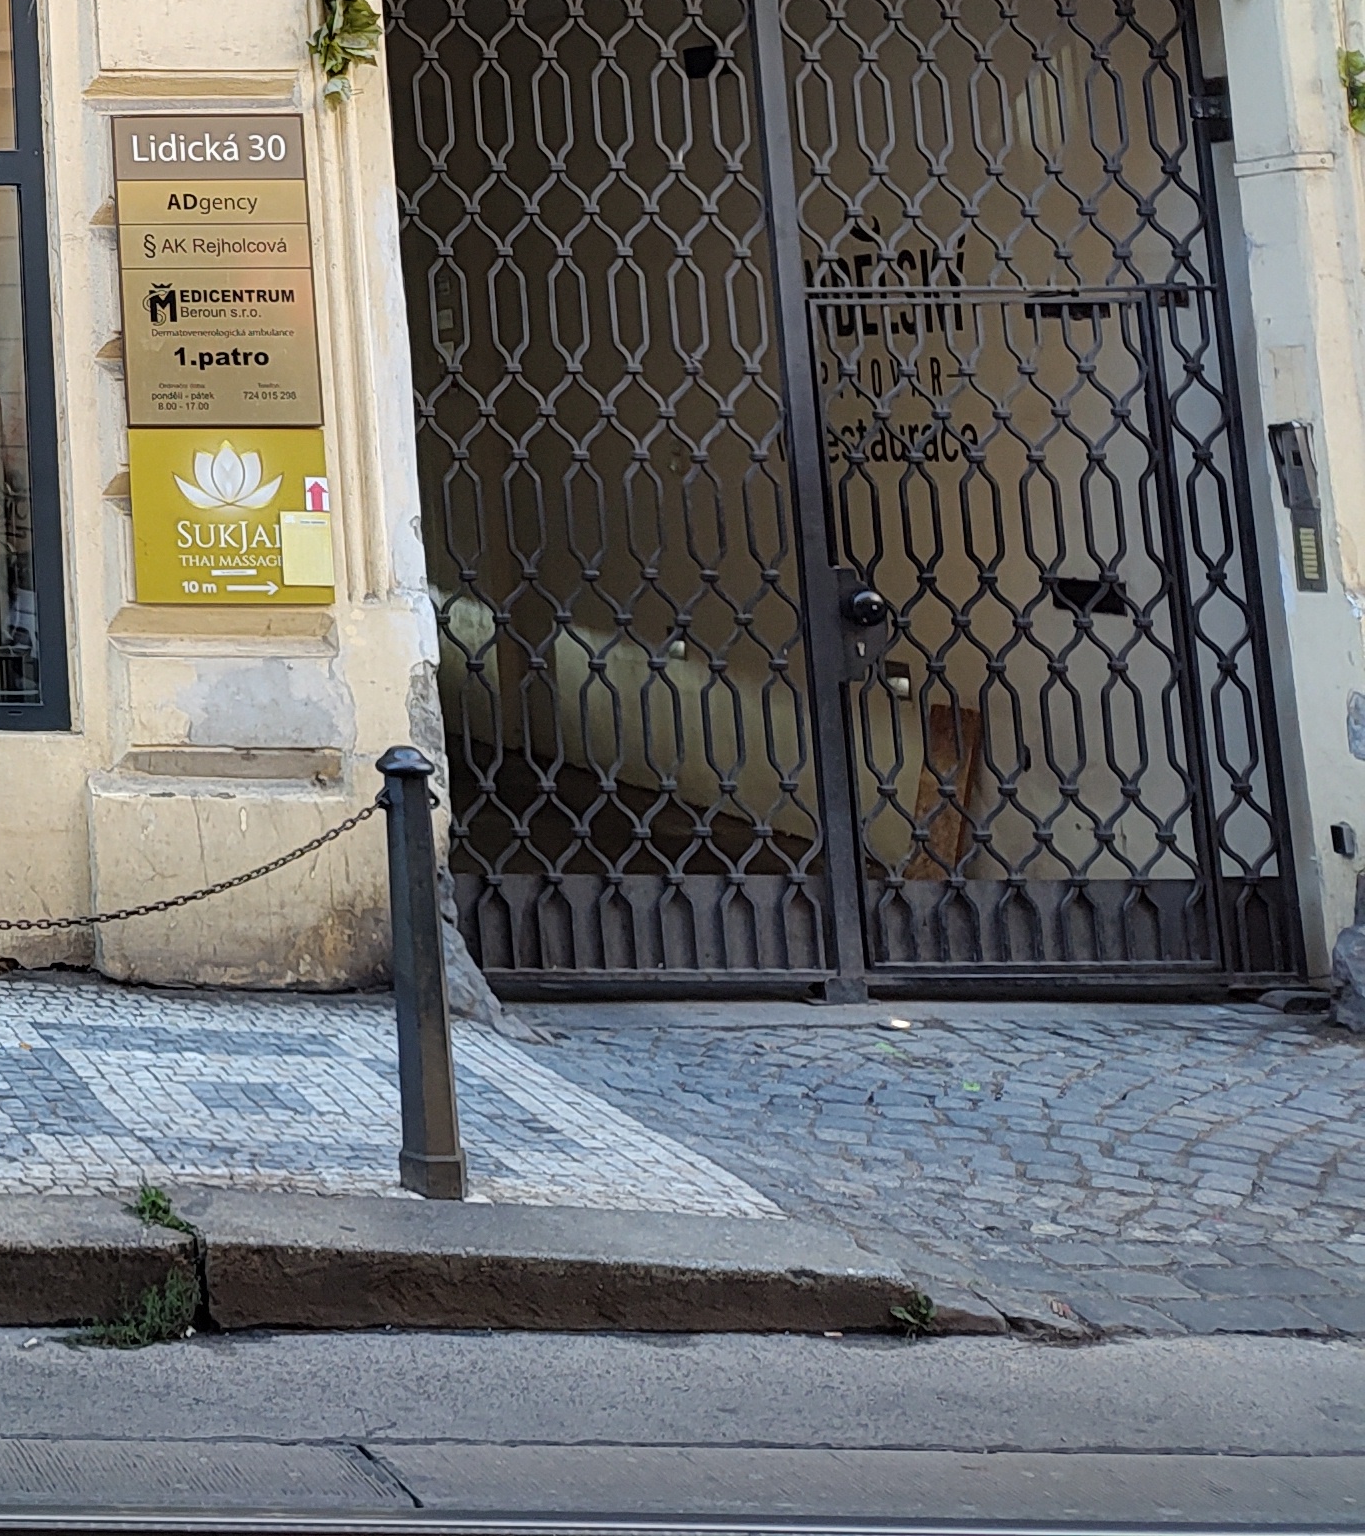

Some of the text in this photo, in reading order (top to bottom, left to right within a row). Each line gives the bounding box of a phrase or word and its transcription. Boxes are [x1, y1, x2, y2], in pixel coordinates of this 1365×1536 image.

[132, 133, 287, 163] Lidická 30
[167, 193, 258, 214] ADgency
[162, 239, 187, 253] AK
[193, 238, 287, 257] Rejholcová
[180, 307, 262, 318] Beroun s.r.o.
[151, 328, 295, 338] Dermatovenerologická ambulance
[174, 347, 270, 370] 1.patro
[191, 391, 215, 401] pátek
[243, 391, 260, 400] 724
[827, 418, 979, 463] estaurace
[179, 555, 215, 567] THAI
[182, 581, 217, 594] 10 m
